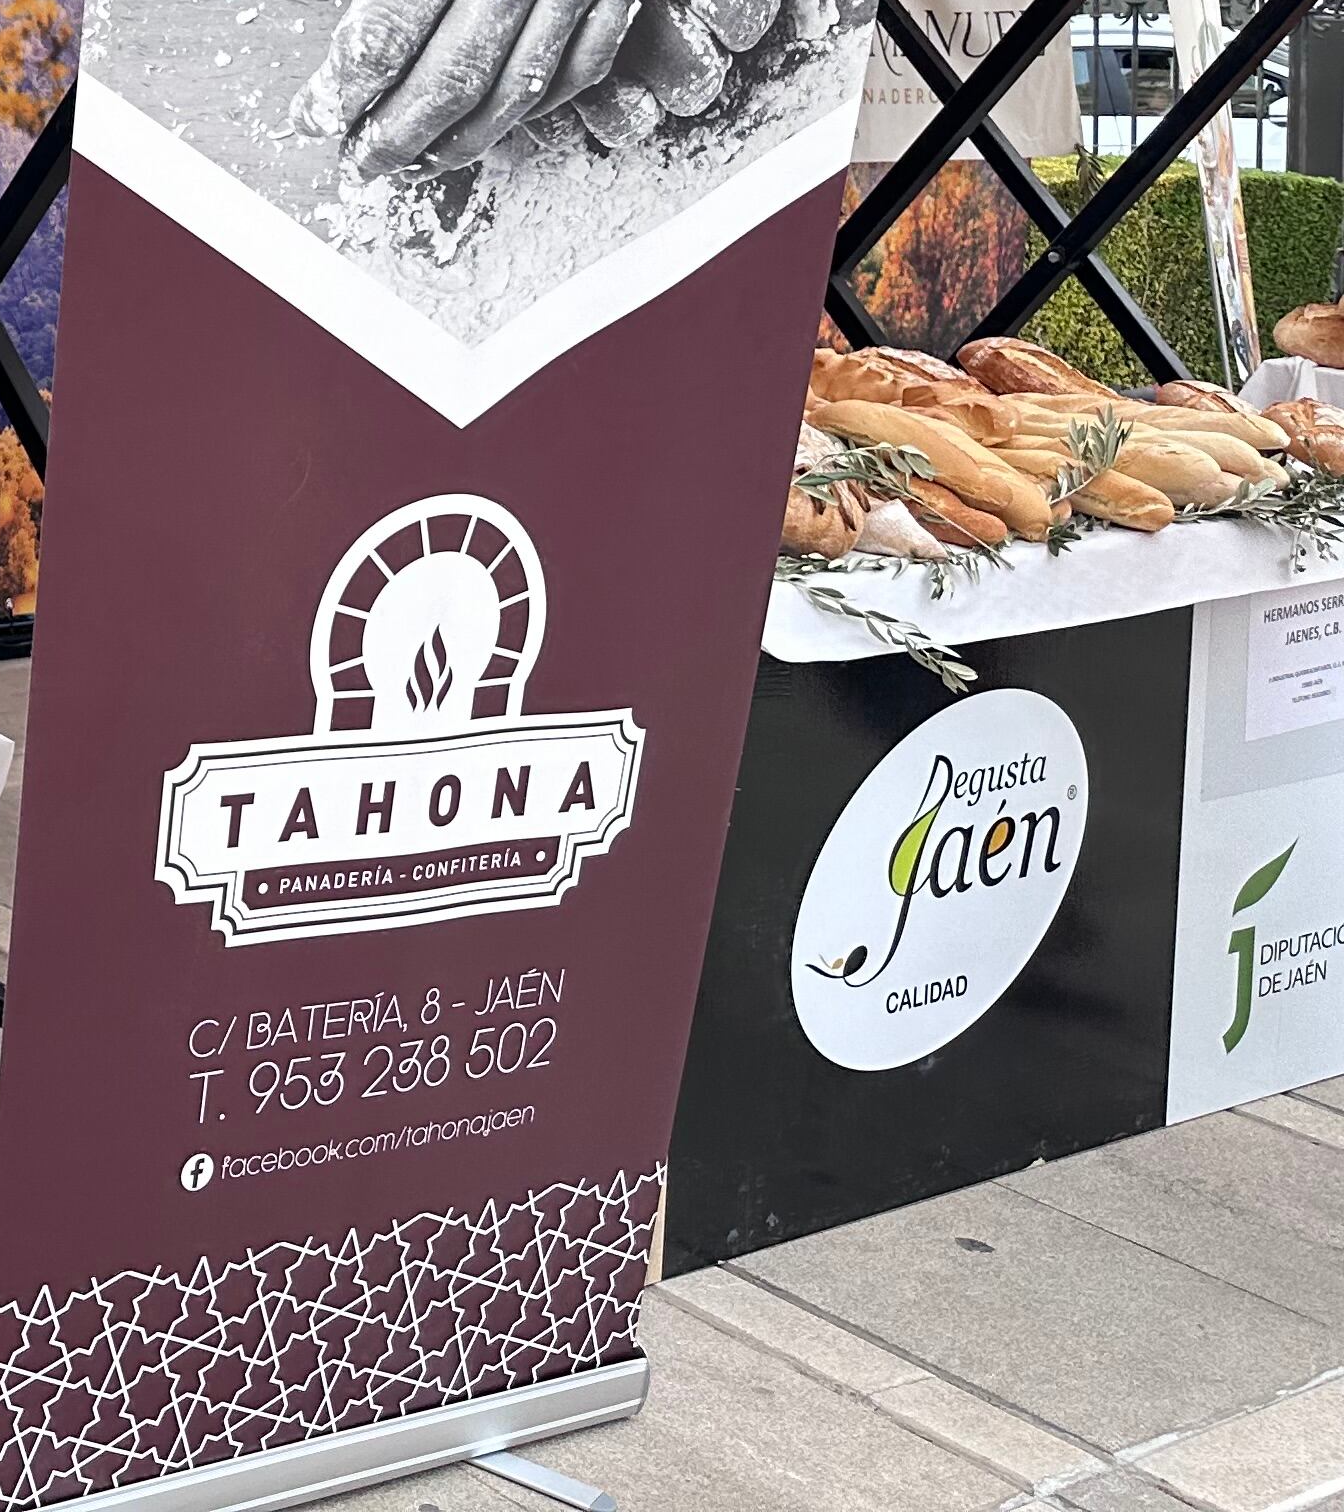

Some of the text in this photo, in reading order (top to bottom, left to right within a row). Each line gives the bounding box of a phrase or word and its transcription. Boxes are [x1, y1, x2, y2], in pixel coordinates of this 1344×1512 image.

[1264, 594, 1344, 623] HERMANOS SERR
[1285, 621, 1342, 646] JAENES, C.B.
[220, 761, 597, 849] TAHONA
[920, 752, 1047, 813] Degusta
[279, 865, 394, 894] PANADERÍA
[412, 848, 522, 882] CONFITERÍA
[886, 975, 968, 1014] CALIDAD
[1258, 960, 1327, 997] DE JAÉN
[189, 1015, 237, 1058] C/
[246, 991, 408, 1051] BATERÍA,
[420, 987, 441, 1023] 8
[474, 968, 565, 1015] JAÉN
[189, 1017, 557, 1123] T. 953 238 502
[221, 1103, 535, 1179] facebook.com/tahonajaen
